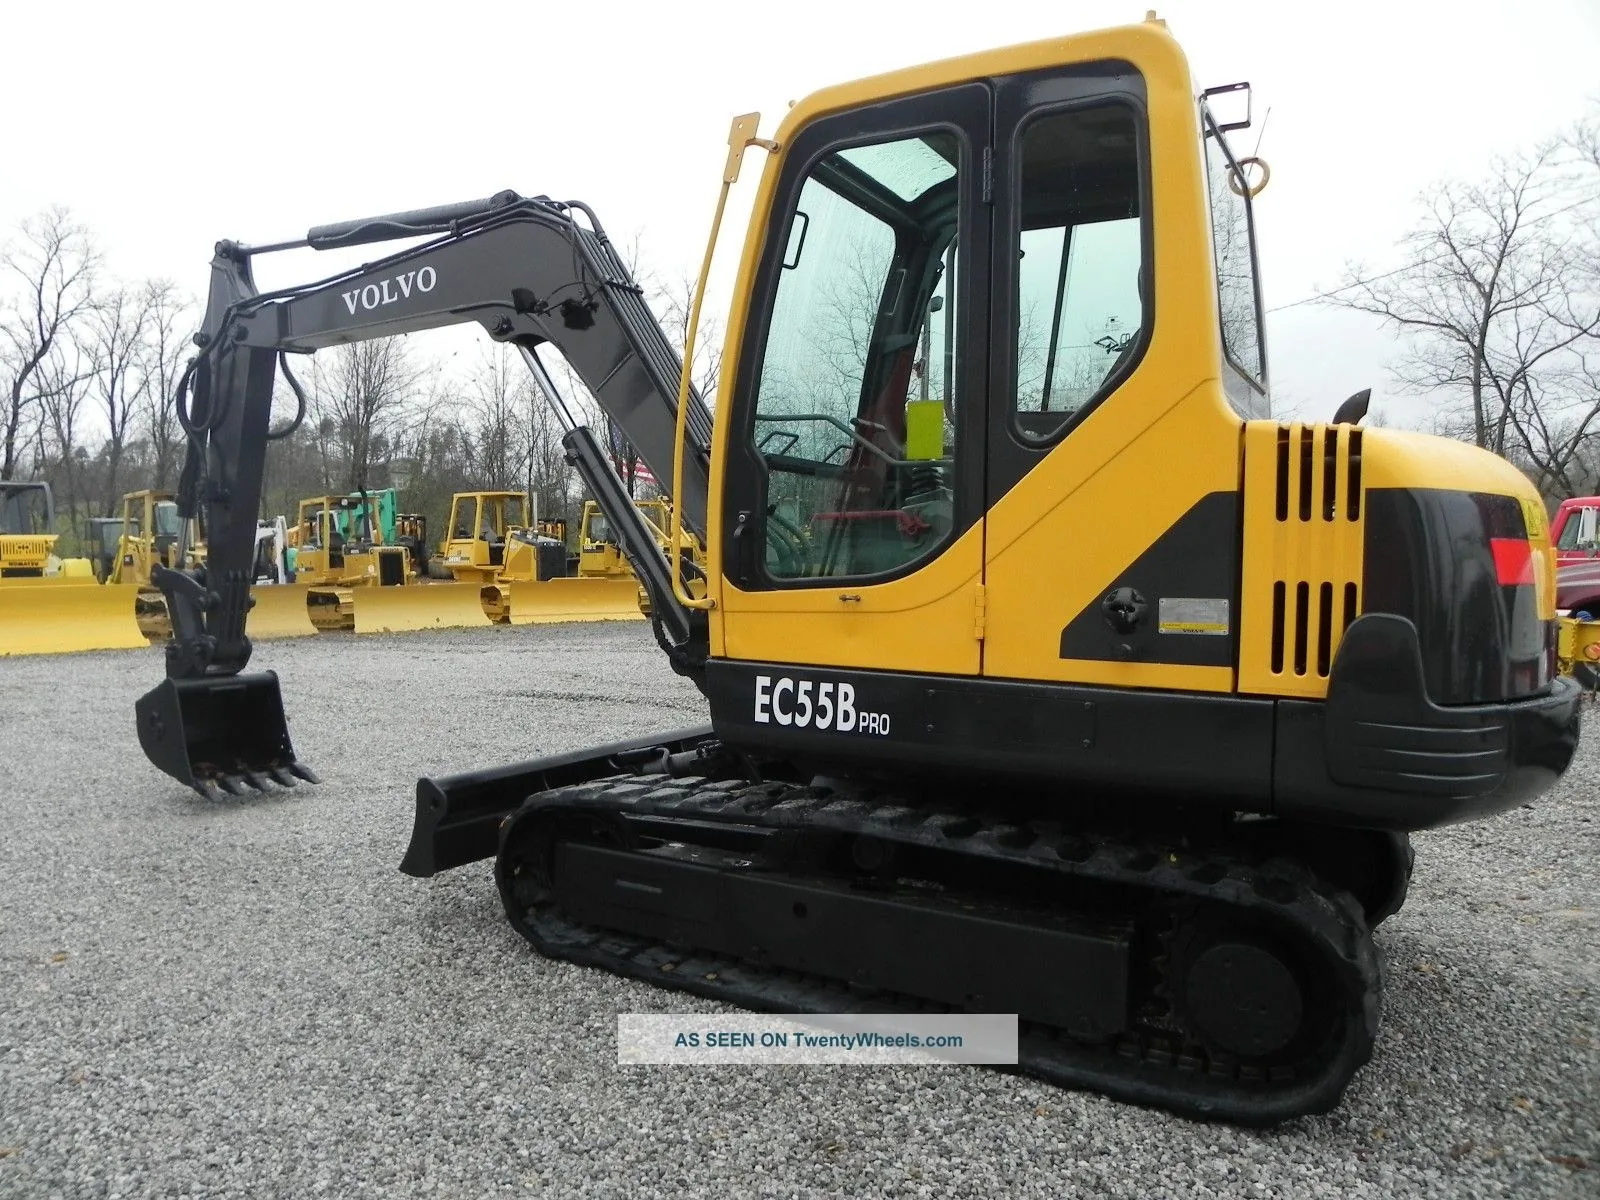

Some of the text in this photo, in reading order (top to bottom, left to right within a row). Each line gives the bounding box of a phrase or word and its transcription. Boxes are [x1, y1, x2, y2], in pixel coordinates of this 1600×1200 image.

[341, 266, 437, 315] VOLVO
[754, 675, 891, 736] EC55B PRO
